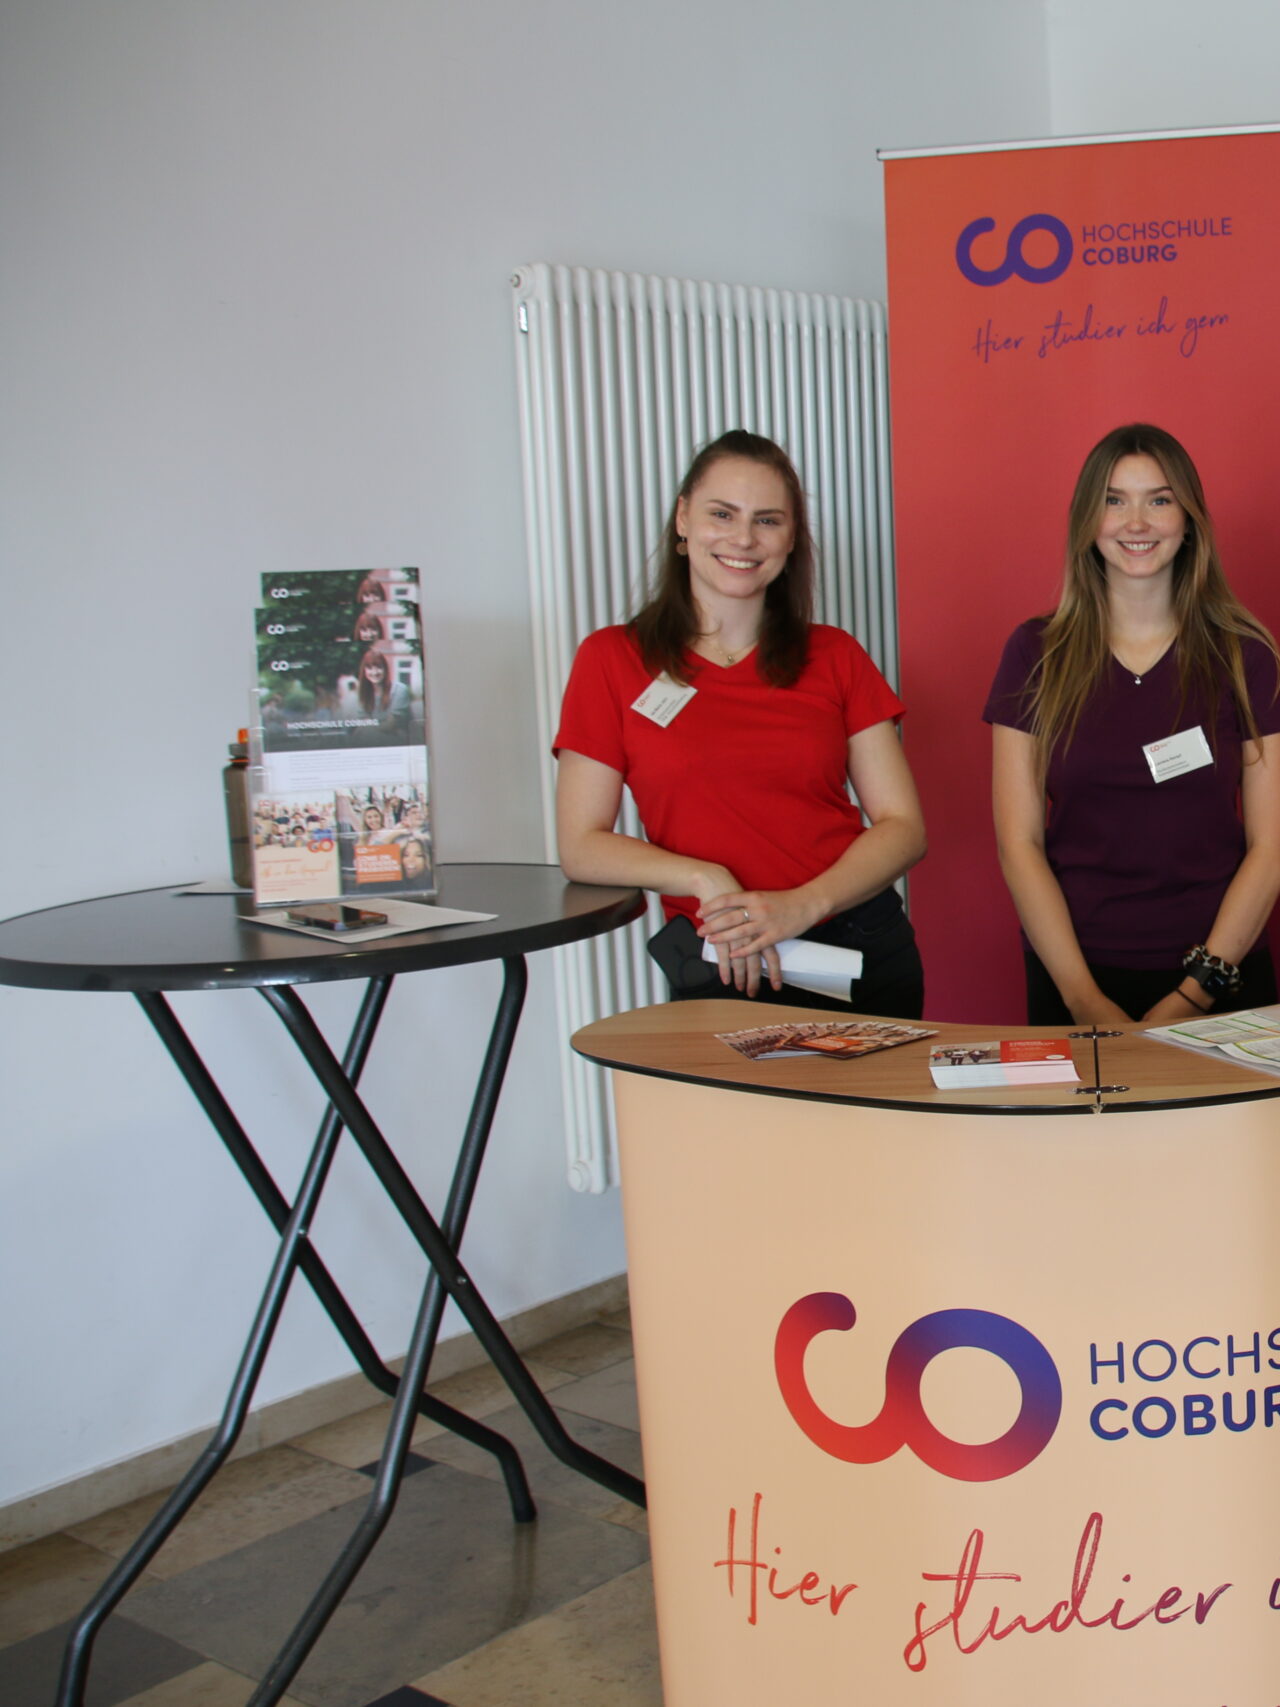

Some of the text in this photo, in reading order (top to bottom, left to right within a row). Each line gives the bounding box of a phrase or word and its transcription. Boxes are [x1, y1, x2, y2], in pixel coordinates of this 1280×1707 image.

[955, 213, 1074, 287] CO
[1082, 217, 1233, 243] HOCHSCHULE
[1082, 244, 1178, 266] COBURG
[971, 296, 1230, 363] Hier studier ich gern
[773, 1291, 1063, 1483] CO
[713, 1492, 858, 1626] Hier
[902, 1512, 1233, 1673] studier
